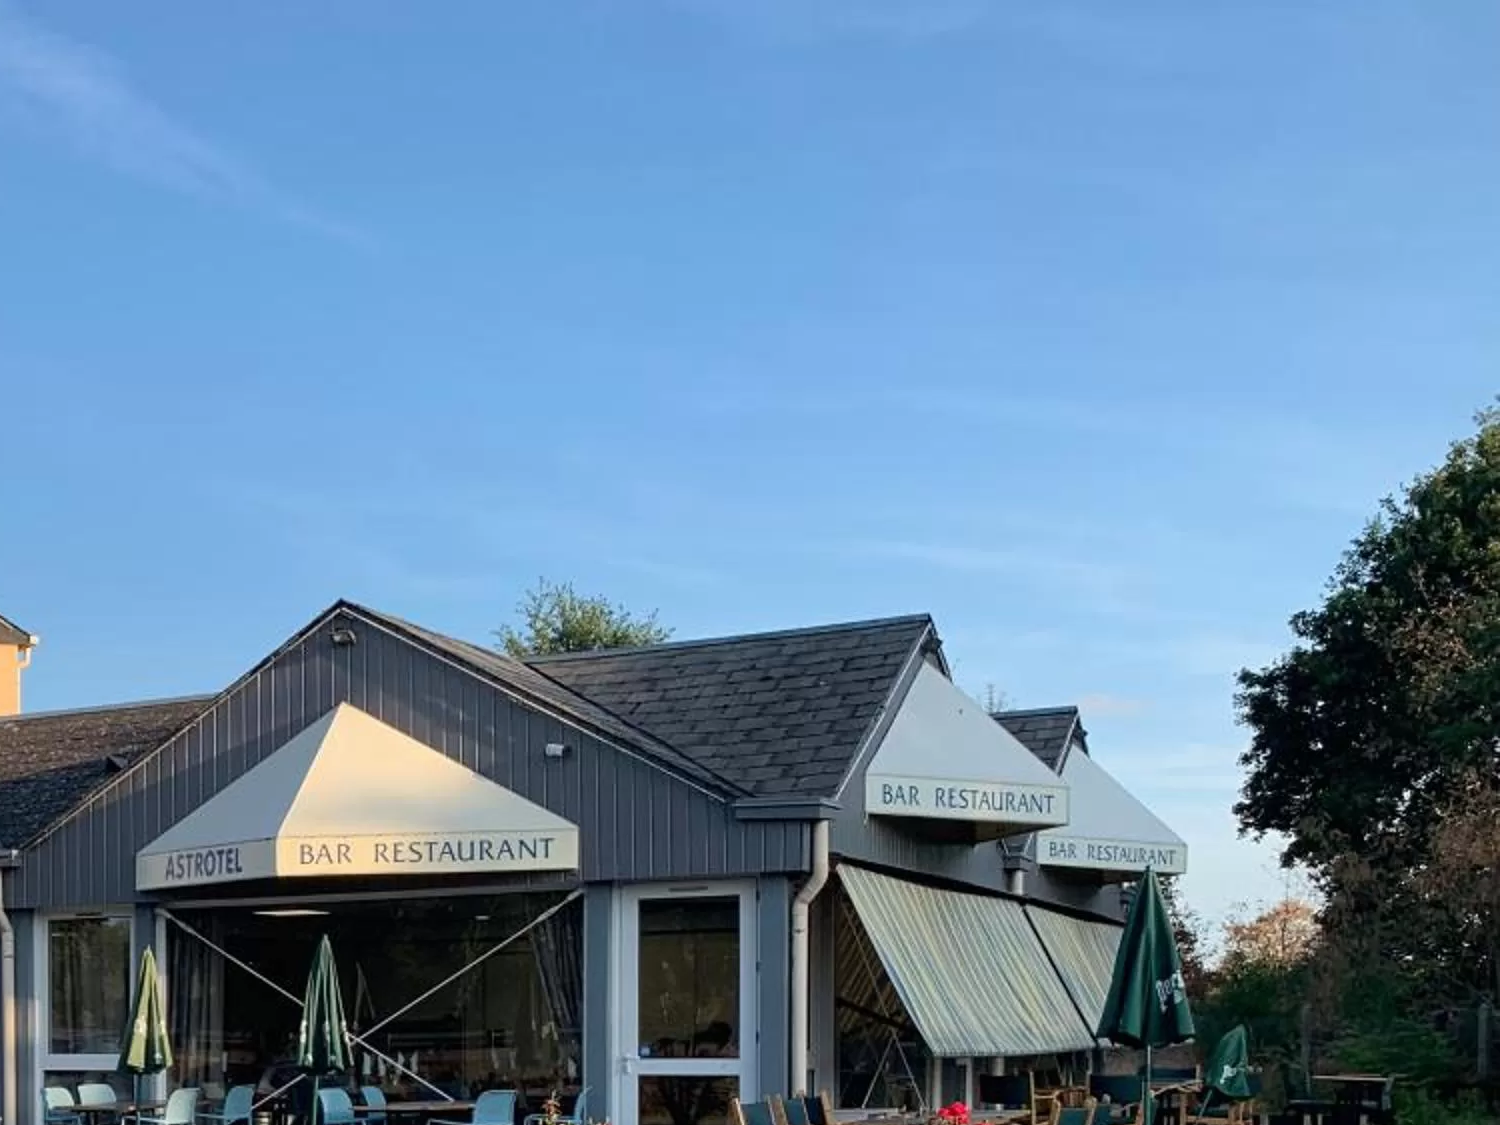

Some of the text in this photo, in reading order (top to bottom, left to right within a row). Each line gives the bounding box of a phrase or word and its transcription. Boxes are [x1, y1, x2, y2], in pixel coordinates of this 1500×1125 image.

[881, 783, 1055, 813] BAR RESTAURANT
[165, 847, 243, 881] ASTROTEL
[299, 837, 556, 866] BAR RESTAURANT
[1049, 841, 1177, 866] BAR RESTAURANT
